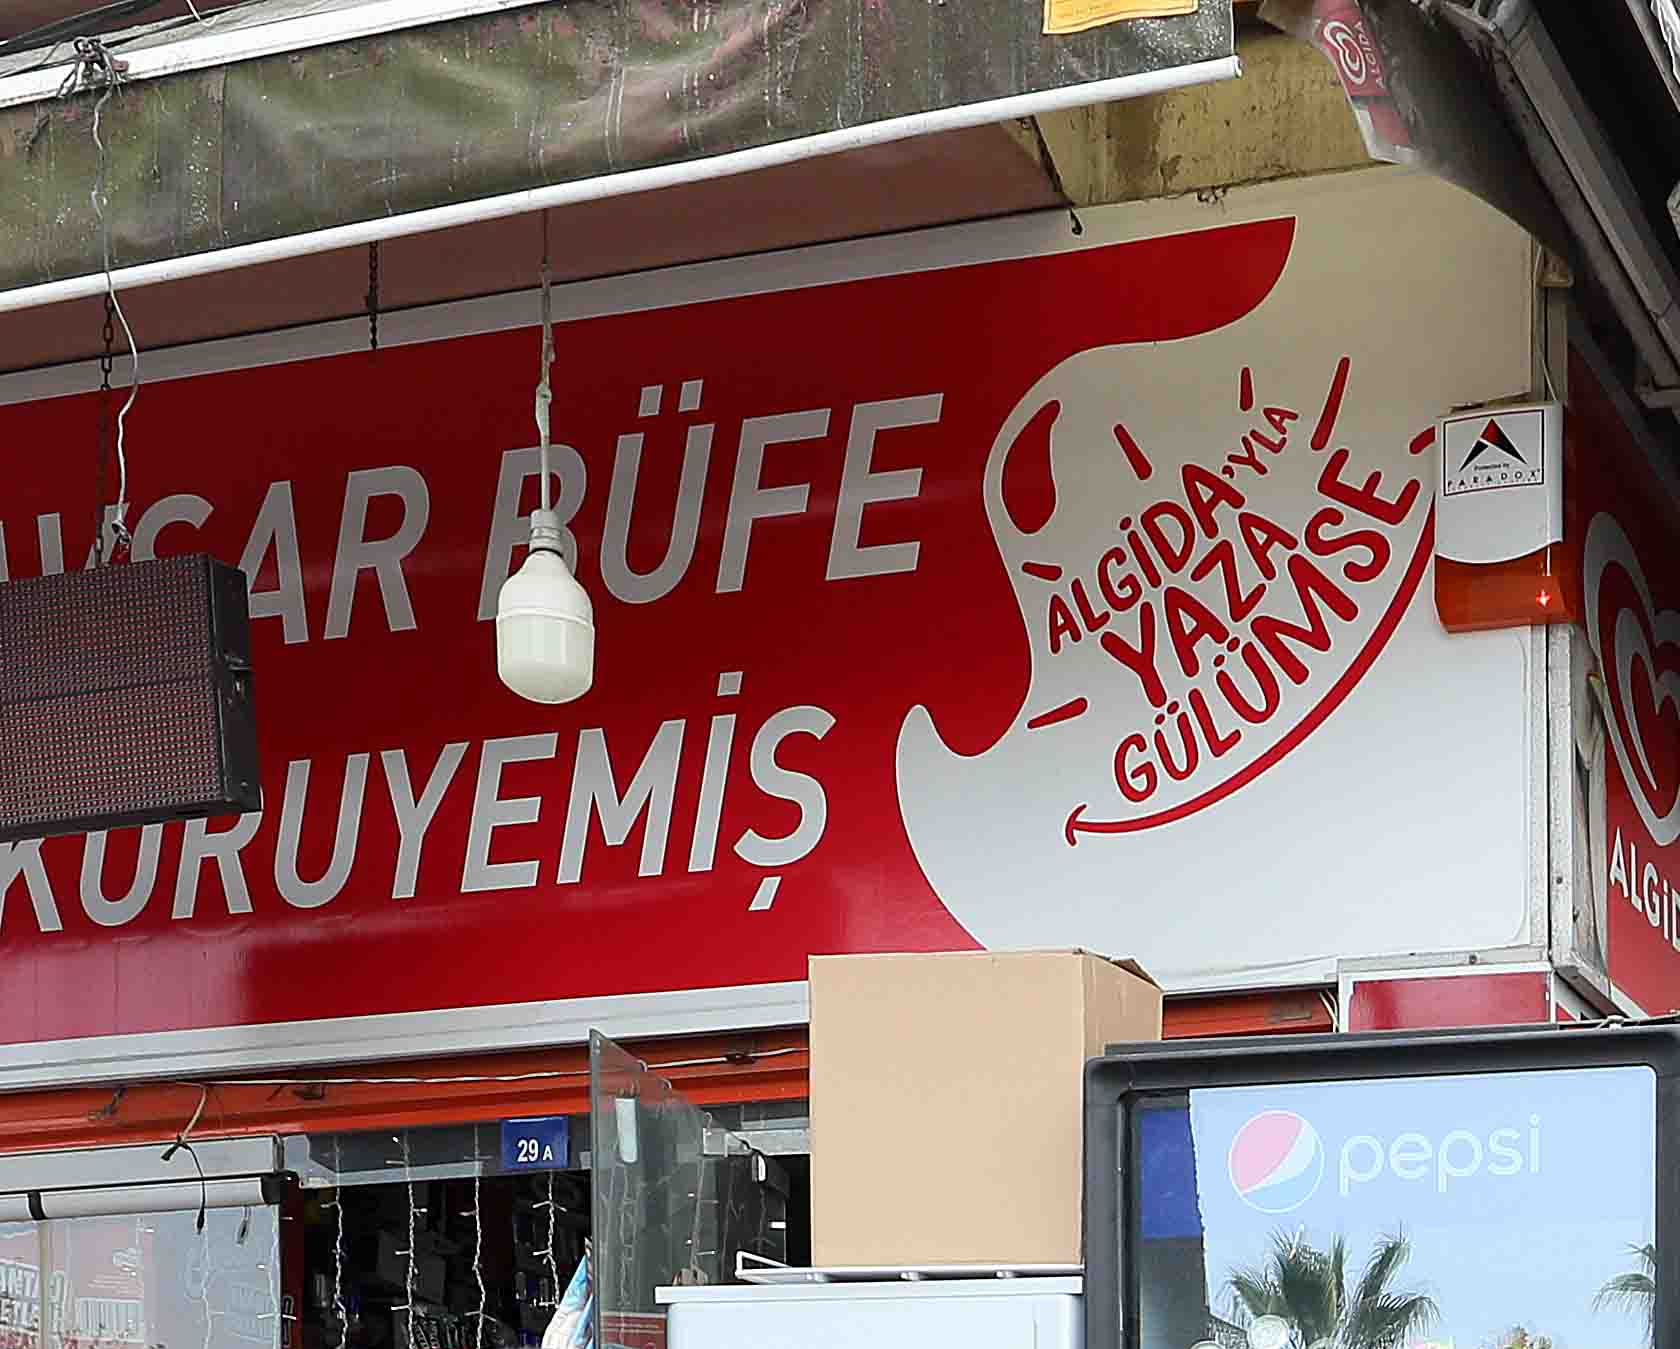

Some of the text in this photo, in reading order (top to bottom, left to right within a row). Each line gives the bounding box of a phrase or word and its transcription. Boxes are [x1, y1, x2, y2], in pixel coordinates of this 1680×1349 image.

[1100, 511, 1298, 708] YAZA
[1114, 448, 1421, 802] GÜLÜMSE
[516, 1138, 553, 1162] 29 A
[1338, 1113, 1542, 1195] pepsi
